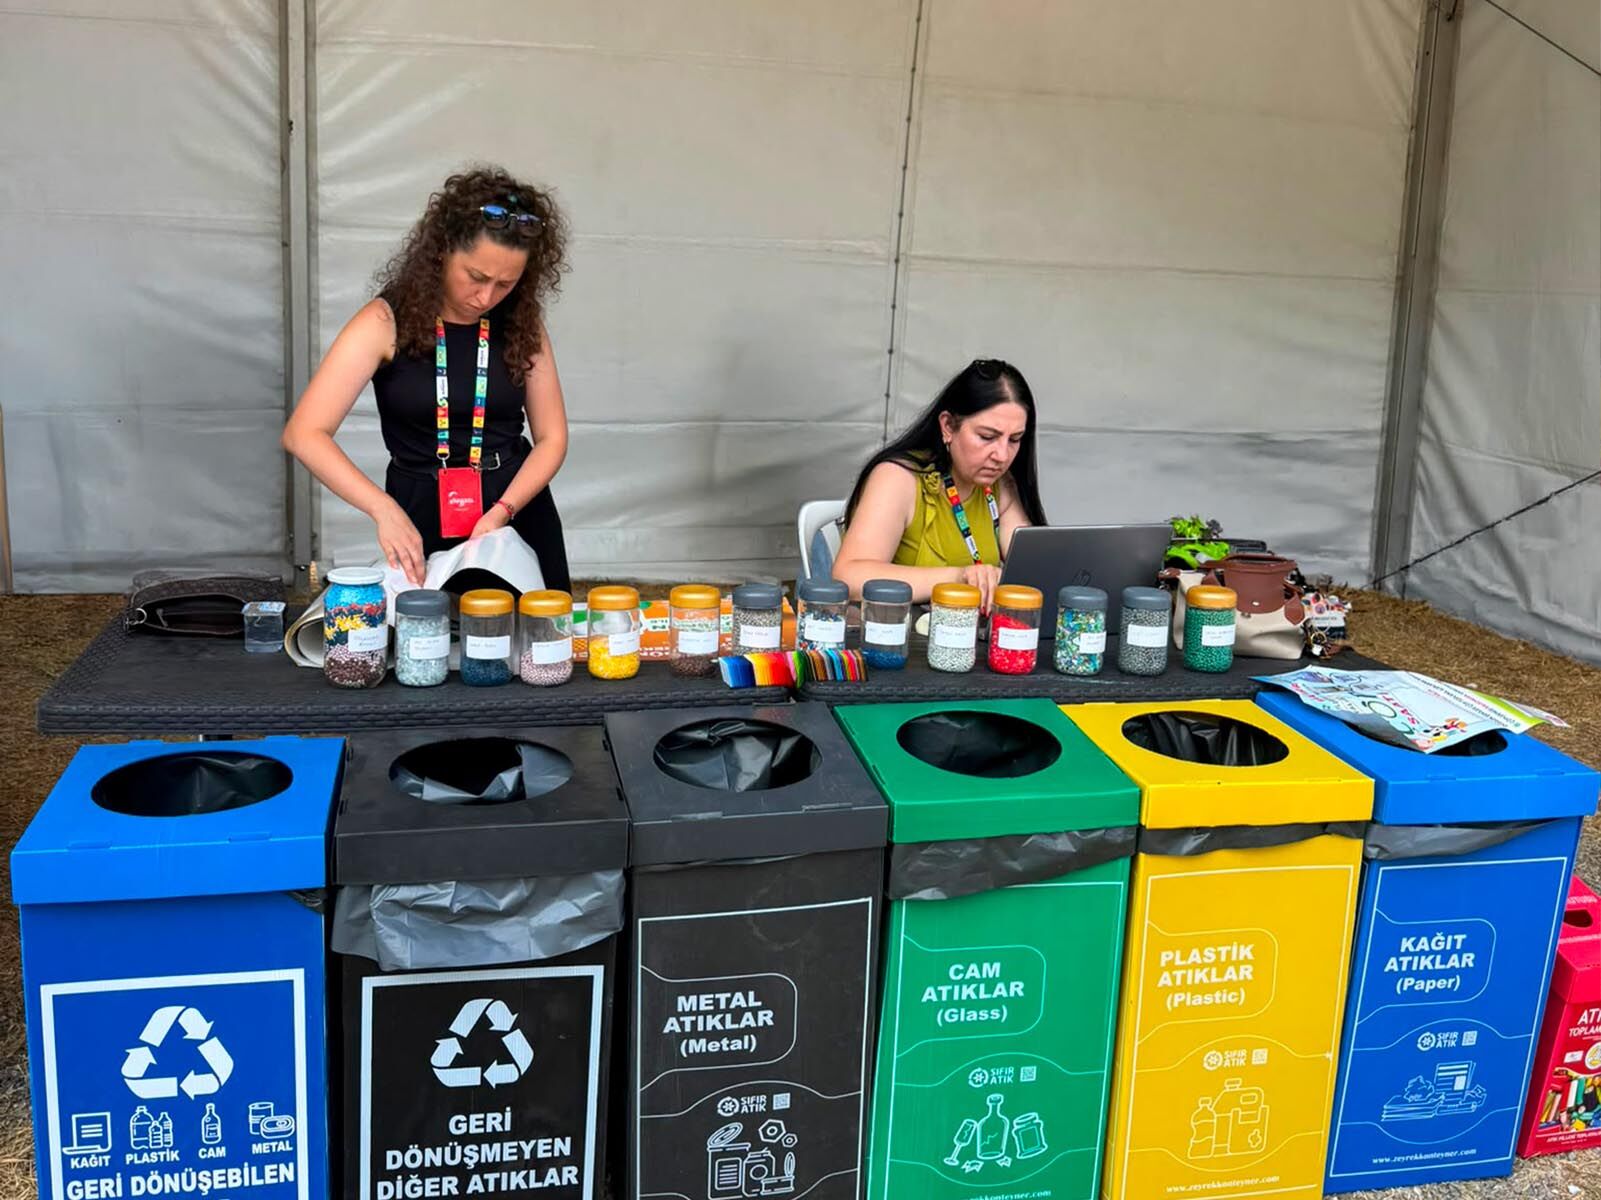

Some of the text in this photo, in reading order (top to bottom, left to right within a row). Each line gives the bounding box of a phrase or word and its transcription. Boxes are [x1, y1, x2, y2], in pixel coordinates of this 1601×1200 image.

[1400, 932, 1467, 952] KAĞIT
[1160, 942, 1254, 967] PLASTİK
[1384, 953, 1475, 972] ATIKLAR
[949, 962, 1001, 981] CAM
[1157, 965, 1254, 988] ATIKLAR
[921, 981, 1025, 1003] ATIKLAR
[1396, 975, 1461, 994] (Paper)
[677, 991, 762, 1012] METAL
[1166, 988, 1246, 1011] (Plastic)
[663, 1010, 774, 1034] ATIKLAR
[936, 1005, 1008, 1027] (Glass)
[680, 1034, 757, 1057] (Metal)
[1435, 1039, 1457, 1049] ATIK
[1436, 1031, 1459, 1041] SIFIR
[1223, 1058, 1247, 1068] ATIK
[1224, 1049, 1248, 1060] SIFIR
[990, 1067, 1015, 1077] SIFIR
[990, 1075, 1014, 1085] ATIK
[740, 1094, 767, 1105] SIFIR
[740, 1103, 767, 1114] ATIK
[449, 1106, 512, 1135] GERİ
[125, 1148, 180, 1165] PLASTİK
[198, 1146, 226, 1159] CAM
[251, 1141, 293, 1154] METAL
[386, 1137, 571, 1169] DÖNÜŞMEYEN
[70, 1154, 111, 1169] KAĞIT
[67, 1162, 295, 1200] GERİ DÖNÜŞEBİLEN
[377, 1165, 579, 1200] DİĞER ATIKLAR
